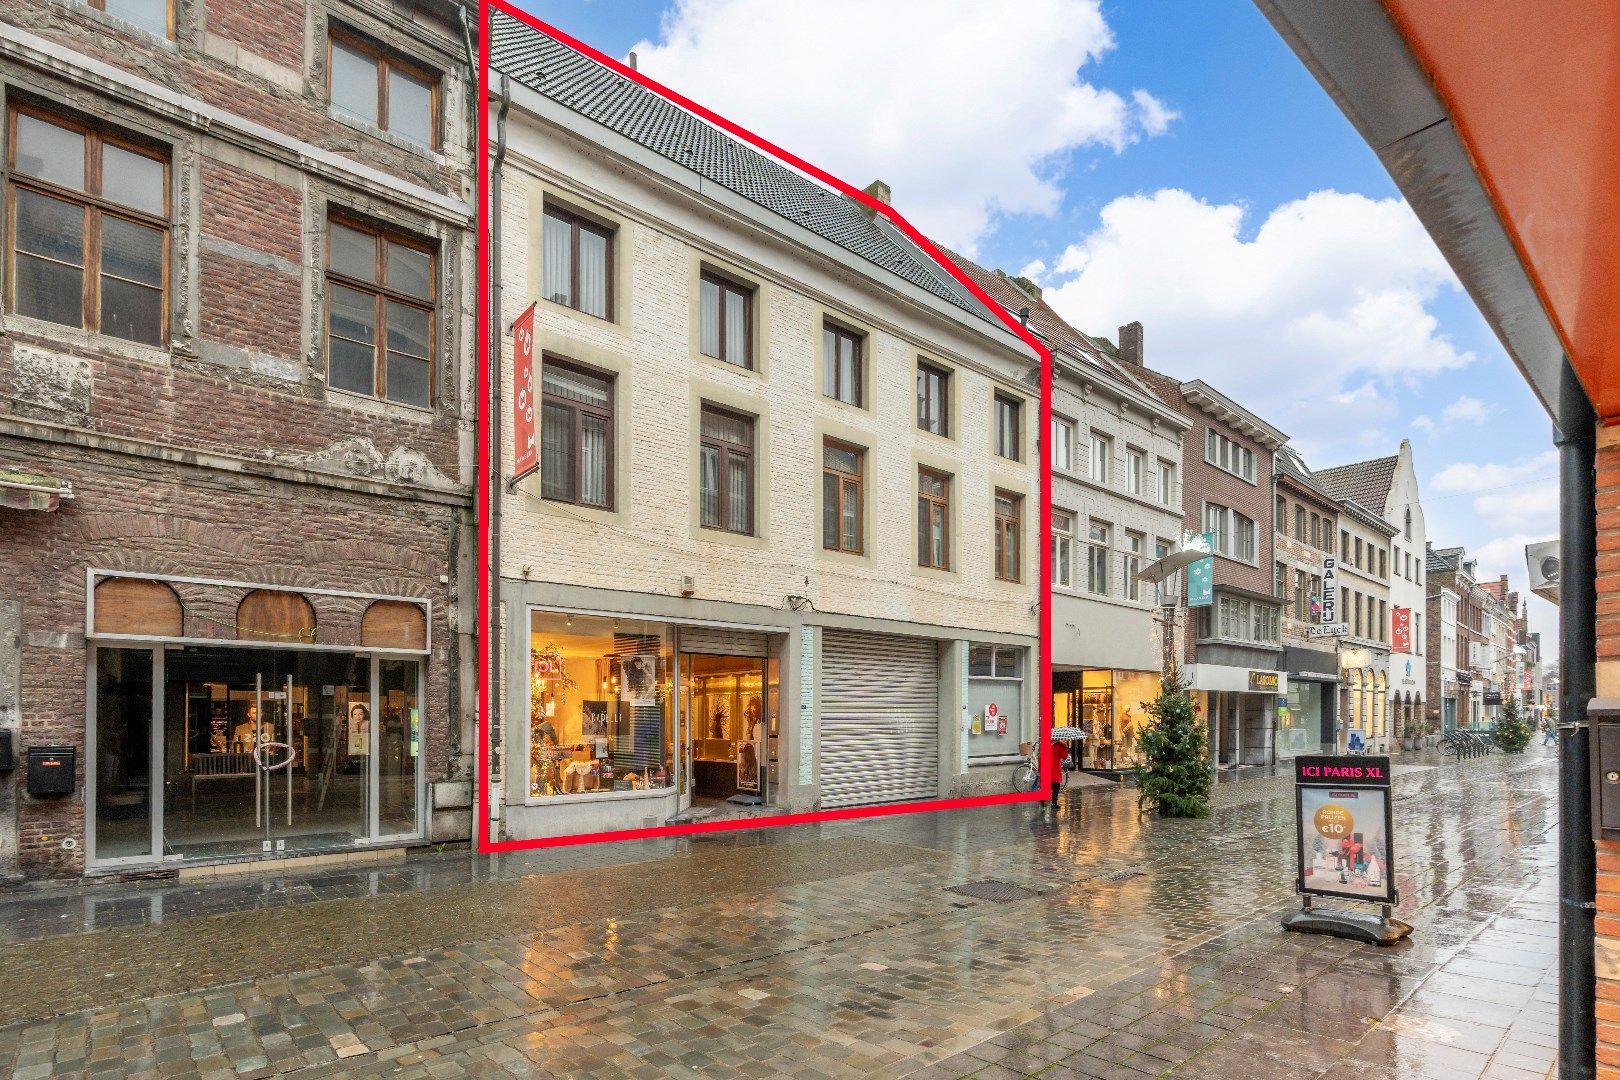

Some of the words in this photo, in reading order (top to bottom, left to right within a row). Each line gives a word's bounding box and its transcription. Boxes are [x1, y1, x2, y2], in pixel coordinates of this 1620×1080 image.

[1323, 559, 1335, 622] GALERIJ
[1301, 766, 1320, 777] ICI
[1323, 766, 1363, 778] PARIS
[1366, 767, 1383, 778] XL
